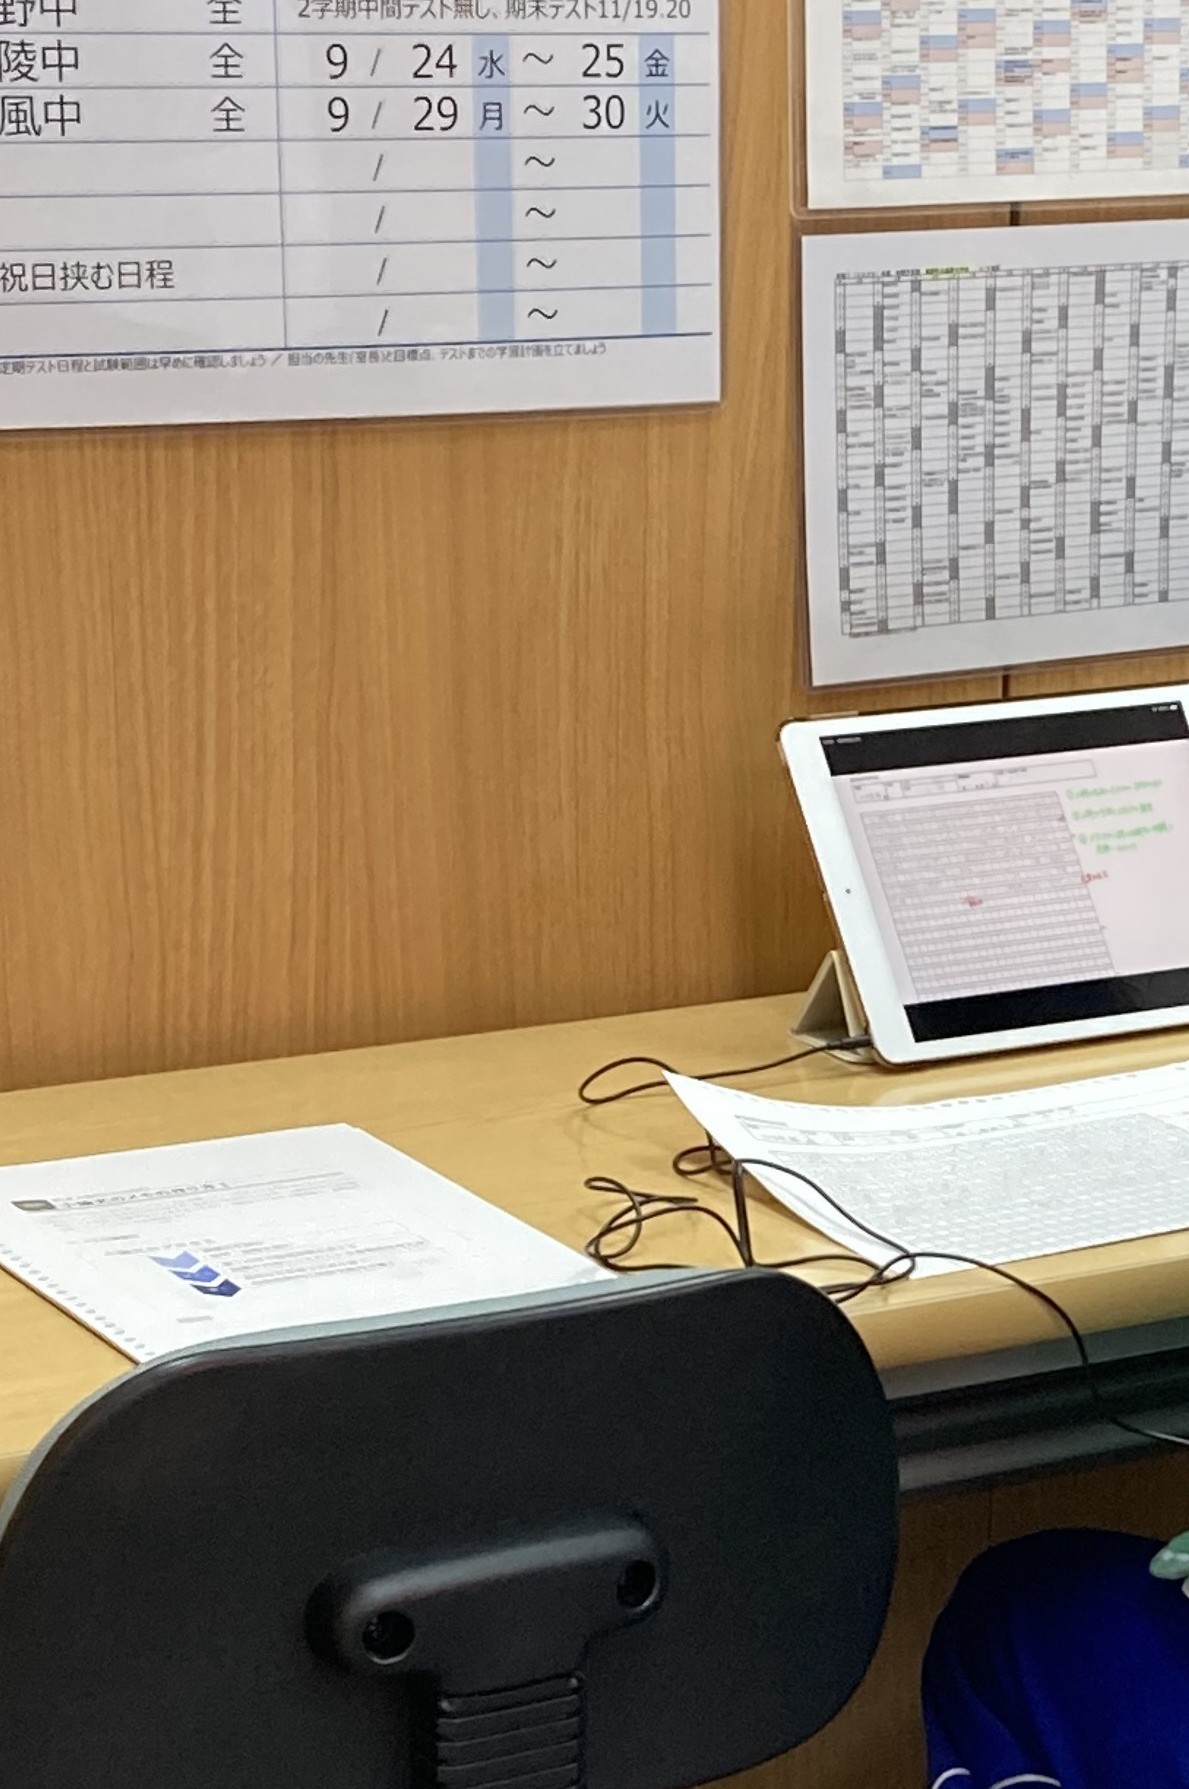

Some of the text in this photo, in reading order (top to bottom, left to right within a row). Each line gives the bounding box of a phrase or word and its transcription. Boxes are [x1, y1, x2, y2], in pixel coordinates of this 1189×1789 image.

[0, 39, 79, 82] 陵中
[209, 42, 244, 79] 全
[326, 43, 348, 79] 9
[412, 43, 458, 78] 24
[477, 50, 506, 79] 水
[582, 43, 625, 78] 25
[644, 48, 670, 78] 金
[0, 94, 81, 136] 風中
[211, 96, 245, 132] 全
[327, 97, 349, 131] 9
[413, 96, 458, 131] 29
[478, 102, 503, 131] 月
[582, 95, 625, 130] 30
[645, 100, 670, 129] 火
[0, 260, 175, 293] 祝日挟む日程
